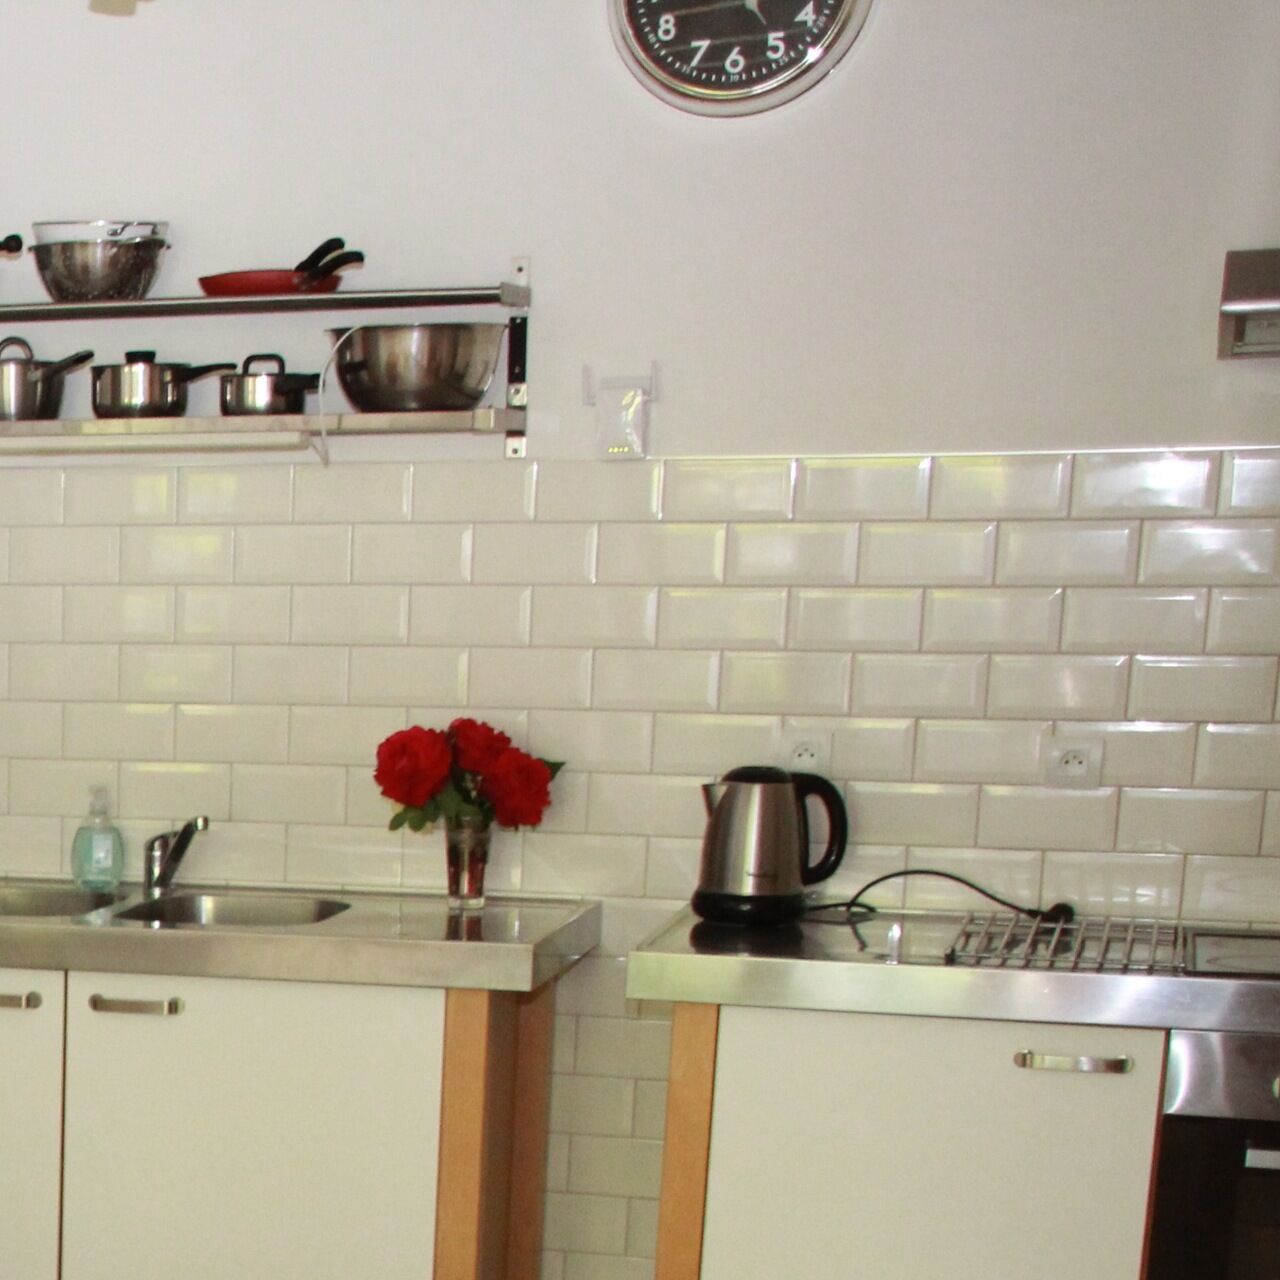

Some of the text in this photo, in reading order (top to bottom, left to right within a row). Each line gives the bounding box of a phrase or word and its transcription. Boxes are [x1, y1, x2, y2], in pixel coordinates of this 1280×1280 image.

[657, 14, 676, 41] 8
[794, 1, 816, 27] 4
[690, 39, 711, 68] 7
[766, 32, 785, 59] 5
[725, 47, 744, 74] 6
